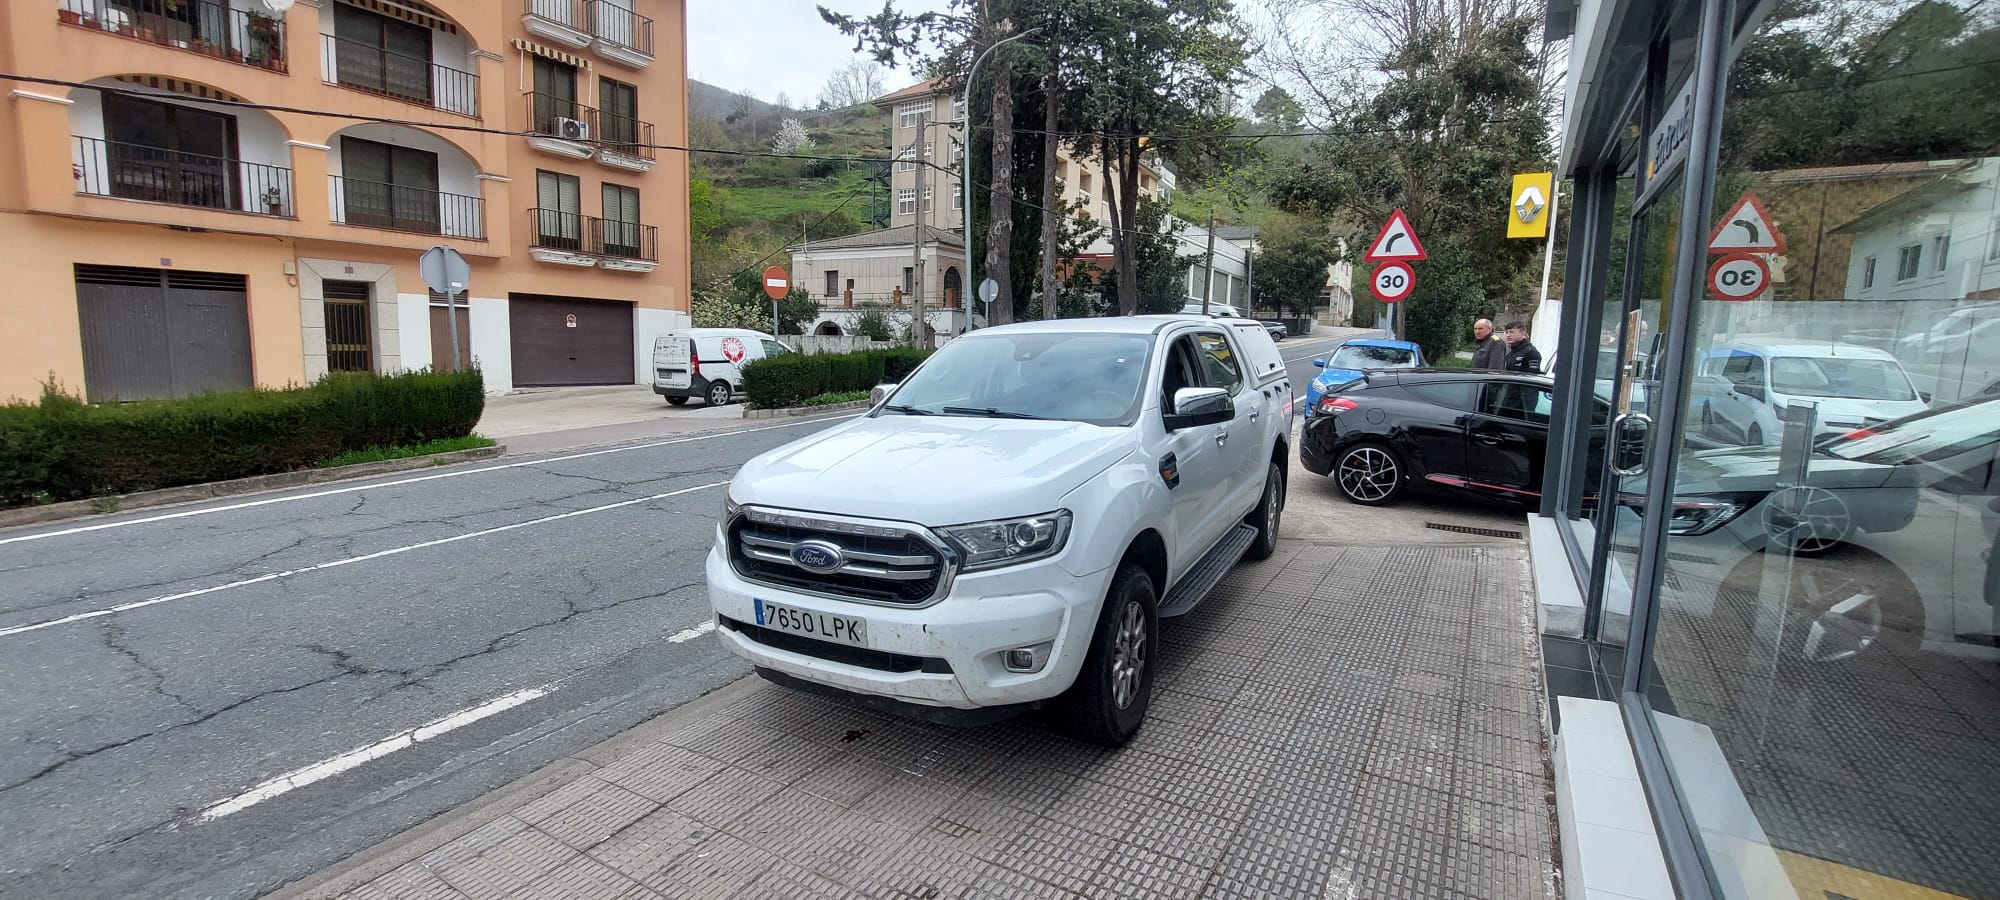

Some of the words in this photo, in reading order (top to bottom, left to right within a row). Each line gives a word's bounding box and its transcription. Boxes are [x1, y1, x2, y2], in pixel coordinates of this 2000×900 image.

[1381, 275, 1404, 288] 30
[800, 549, 826, 565] Ford
[766, 604, 814, 633] 7650
[820, 615, 861, 642] LPK
